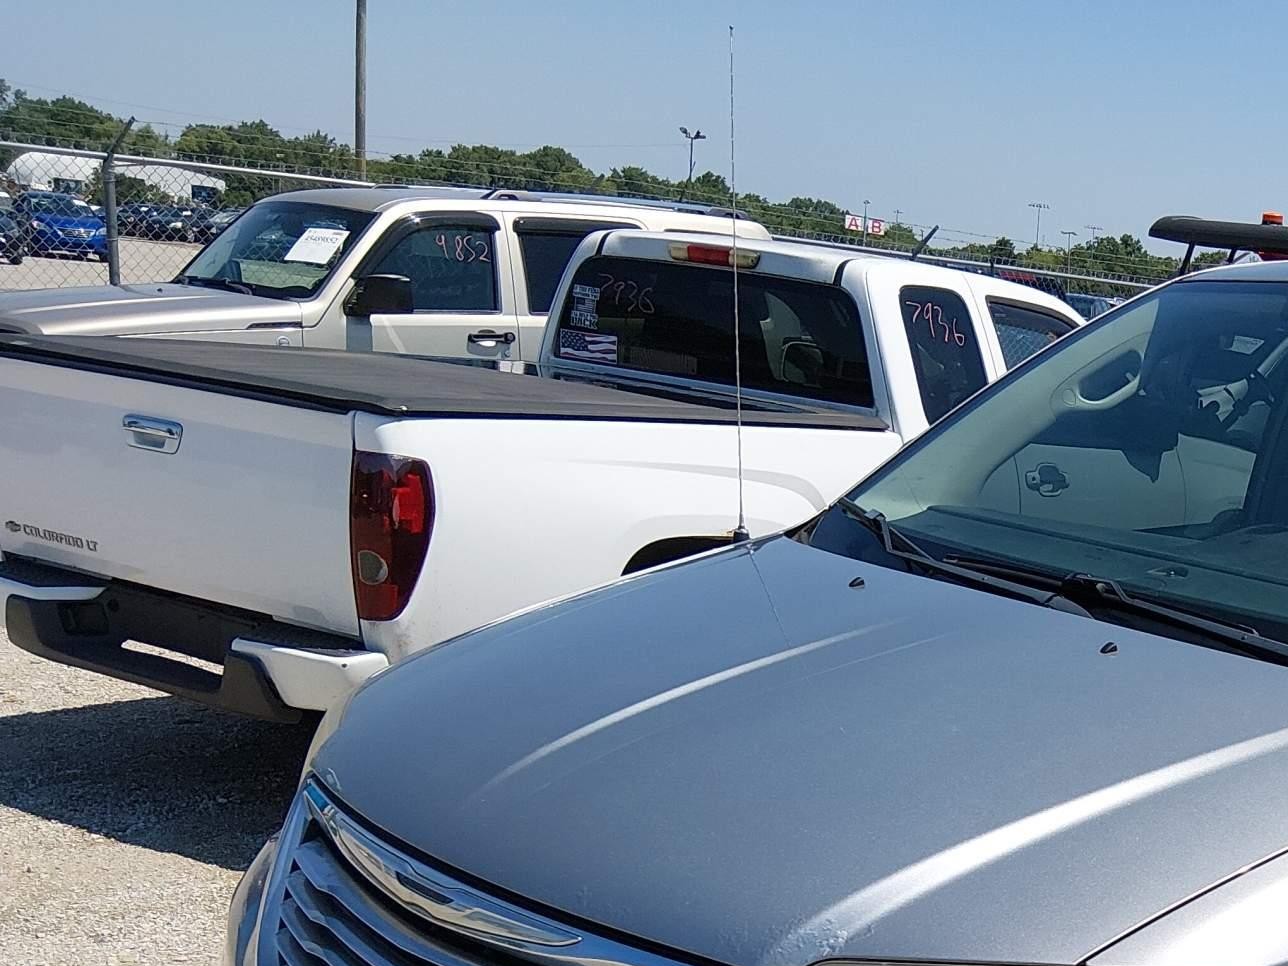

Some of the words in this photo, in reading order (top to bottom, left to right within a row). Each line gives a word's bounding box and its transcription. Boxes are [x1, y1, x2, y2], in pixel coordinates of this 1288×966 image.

[848, 217, 859, 230] A
[871, 219, 881, 233] B
[598, 272, 655, 314] 7936
[905, 301, 965, 346] 7936
[23, 524, 84, 548] COLORADO
[86, 539, 98, 552] LT
